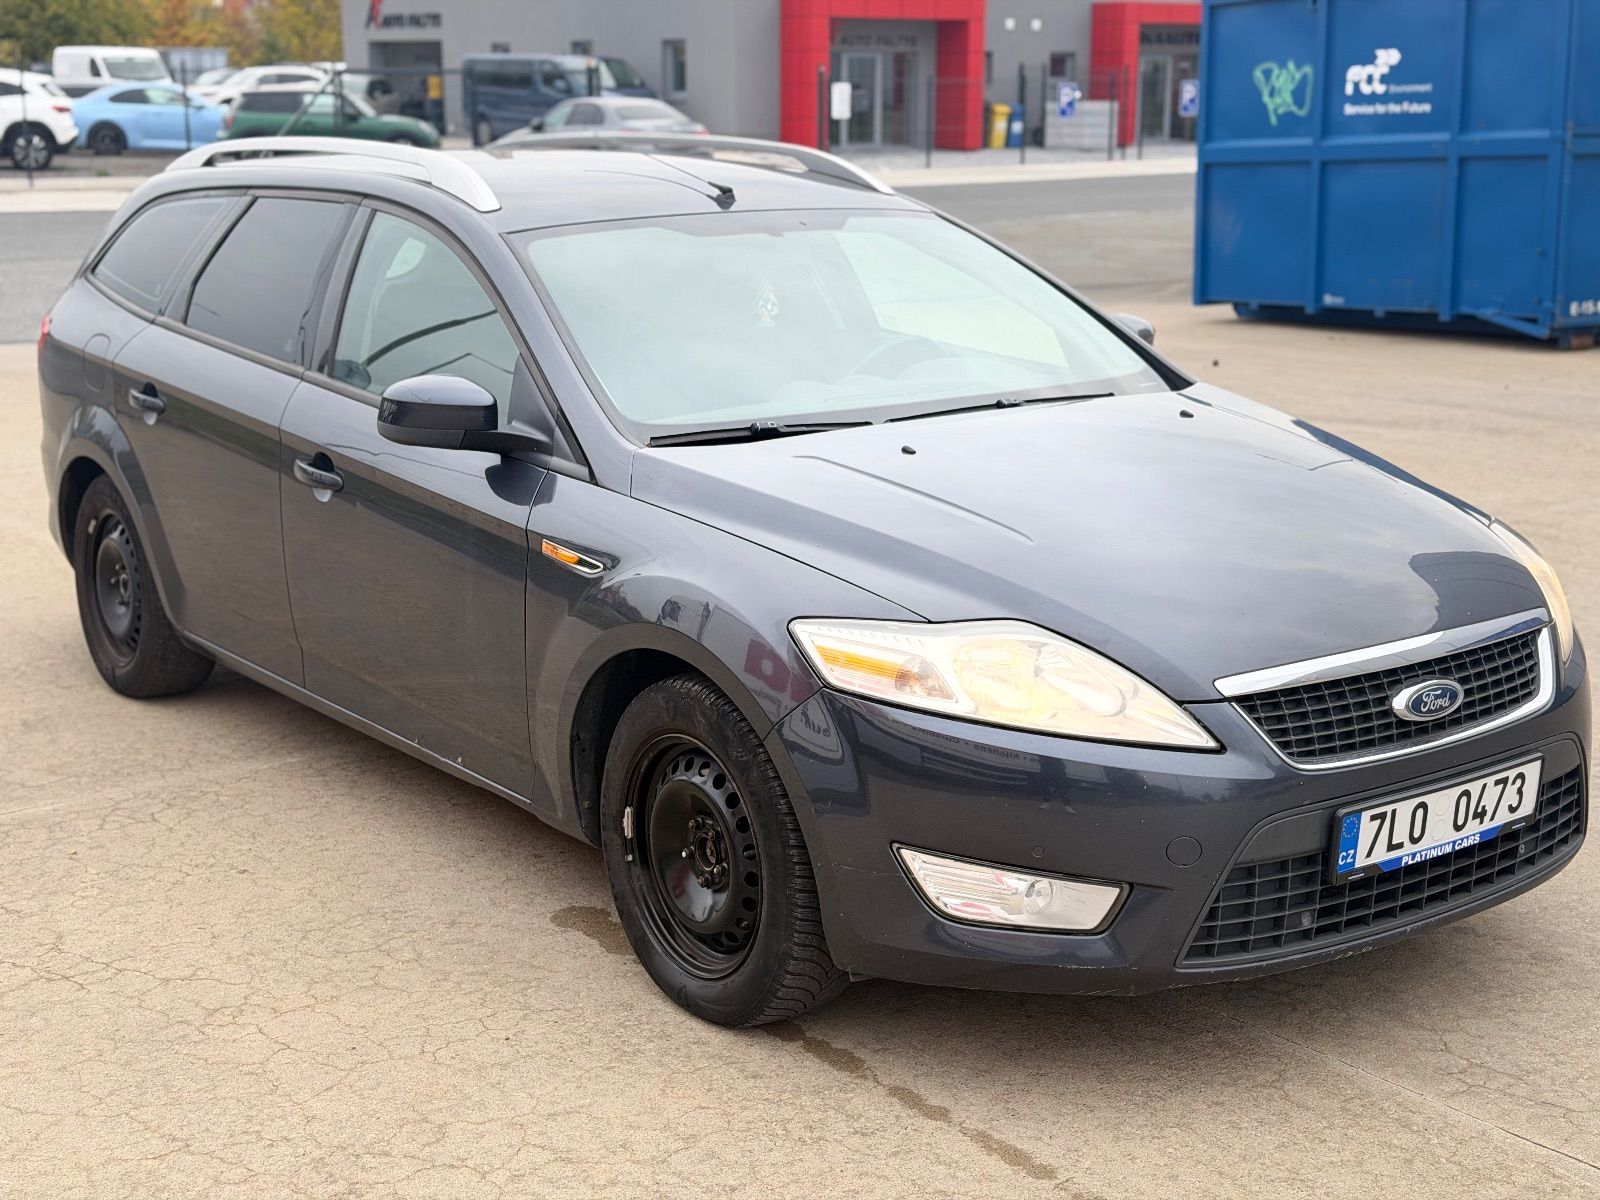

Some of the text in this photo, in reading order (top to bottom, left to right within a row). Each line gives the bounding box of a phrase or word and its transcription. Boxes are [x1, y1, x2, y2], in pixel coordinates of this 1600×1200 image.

[1344, 102, 1375, 116] Service
[1402, 100, 1432, 114] Future
[1420, 690, 1451, 713] Ford
[1452, 771, 1526, 833] 0473
[1338, 849, 1355, 866] CZ
[1401, 834, 1480, 867] PLATINUM CARS
